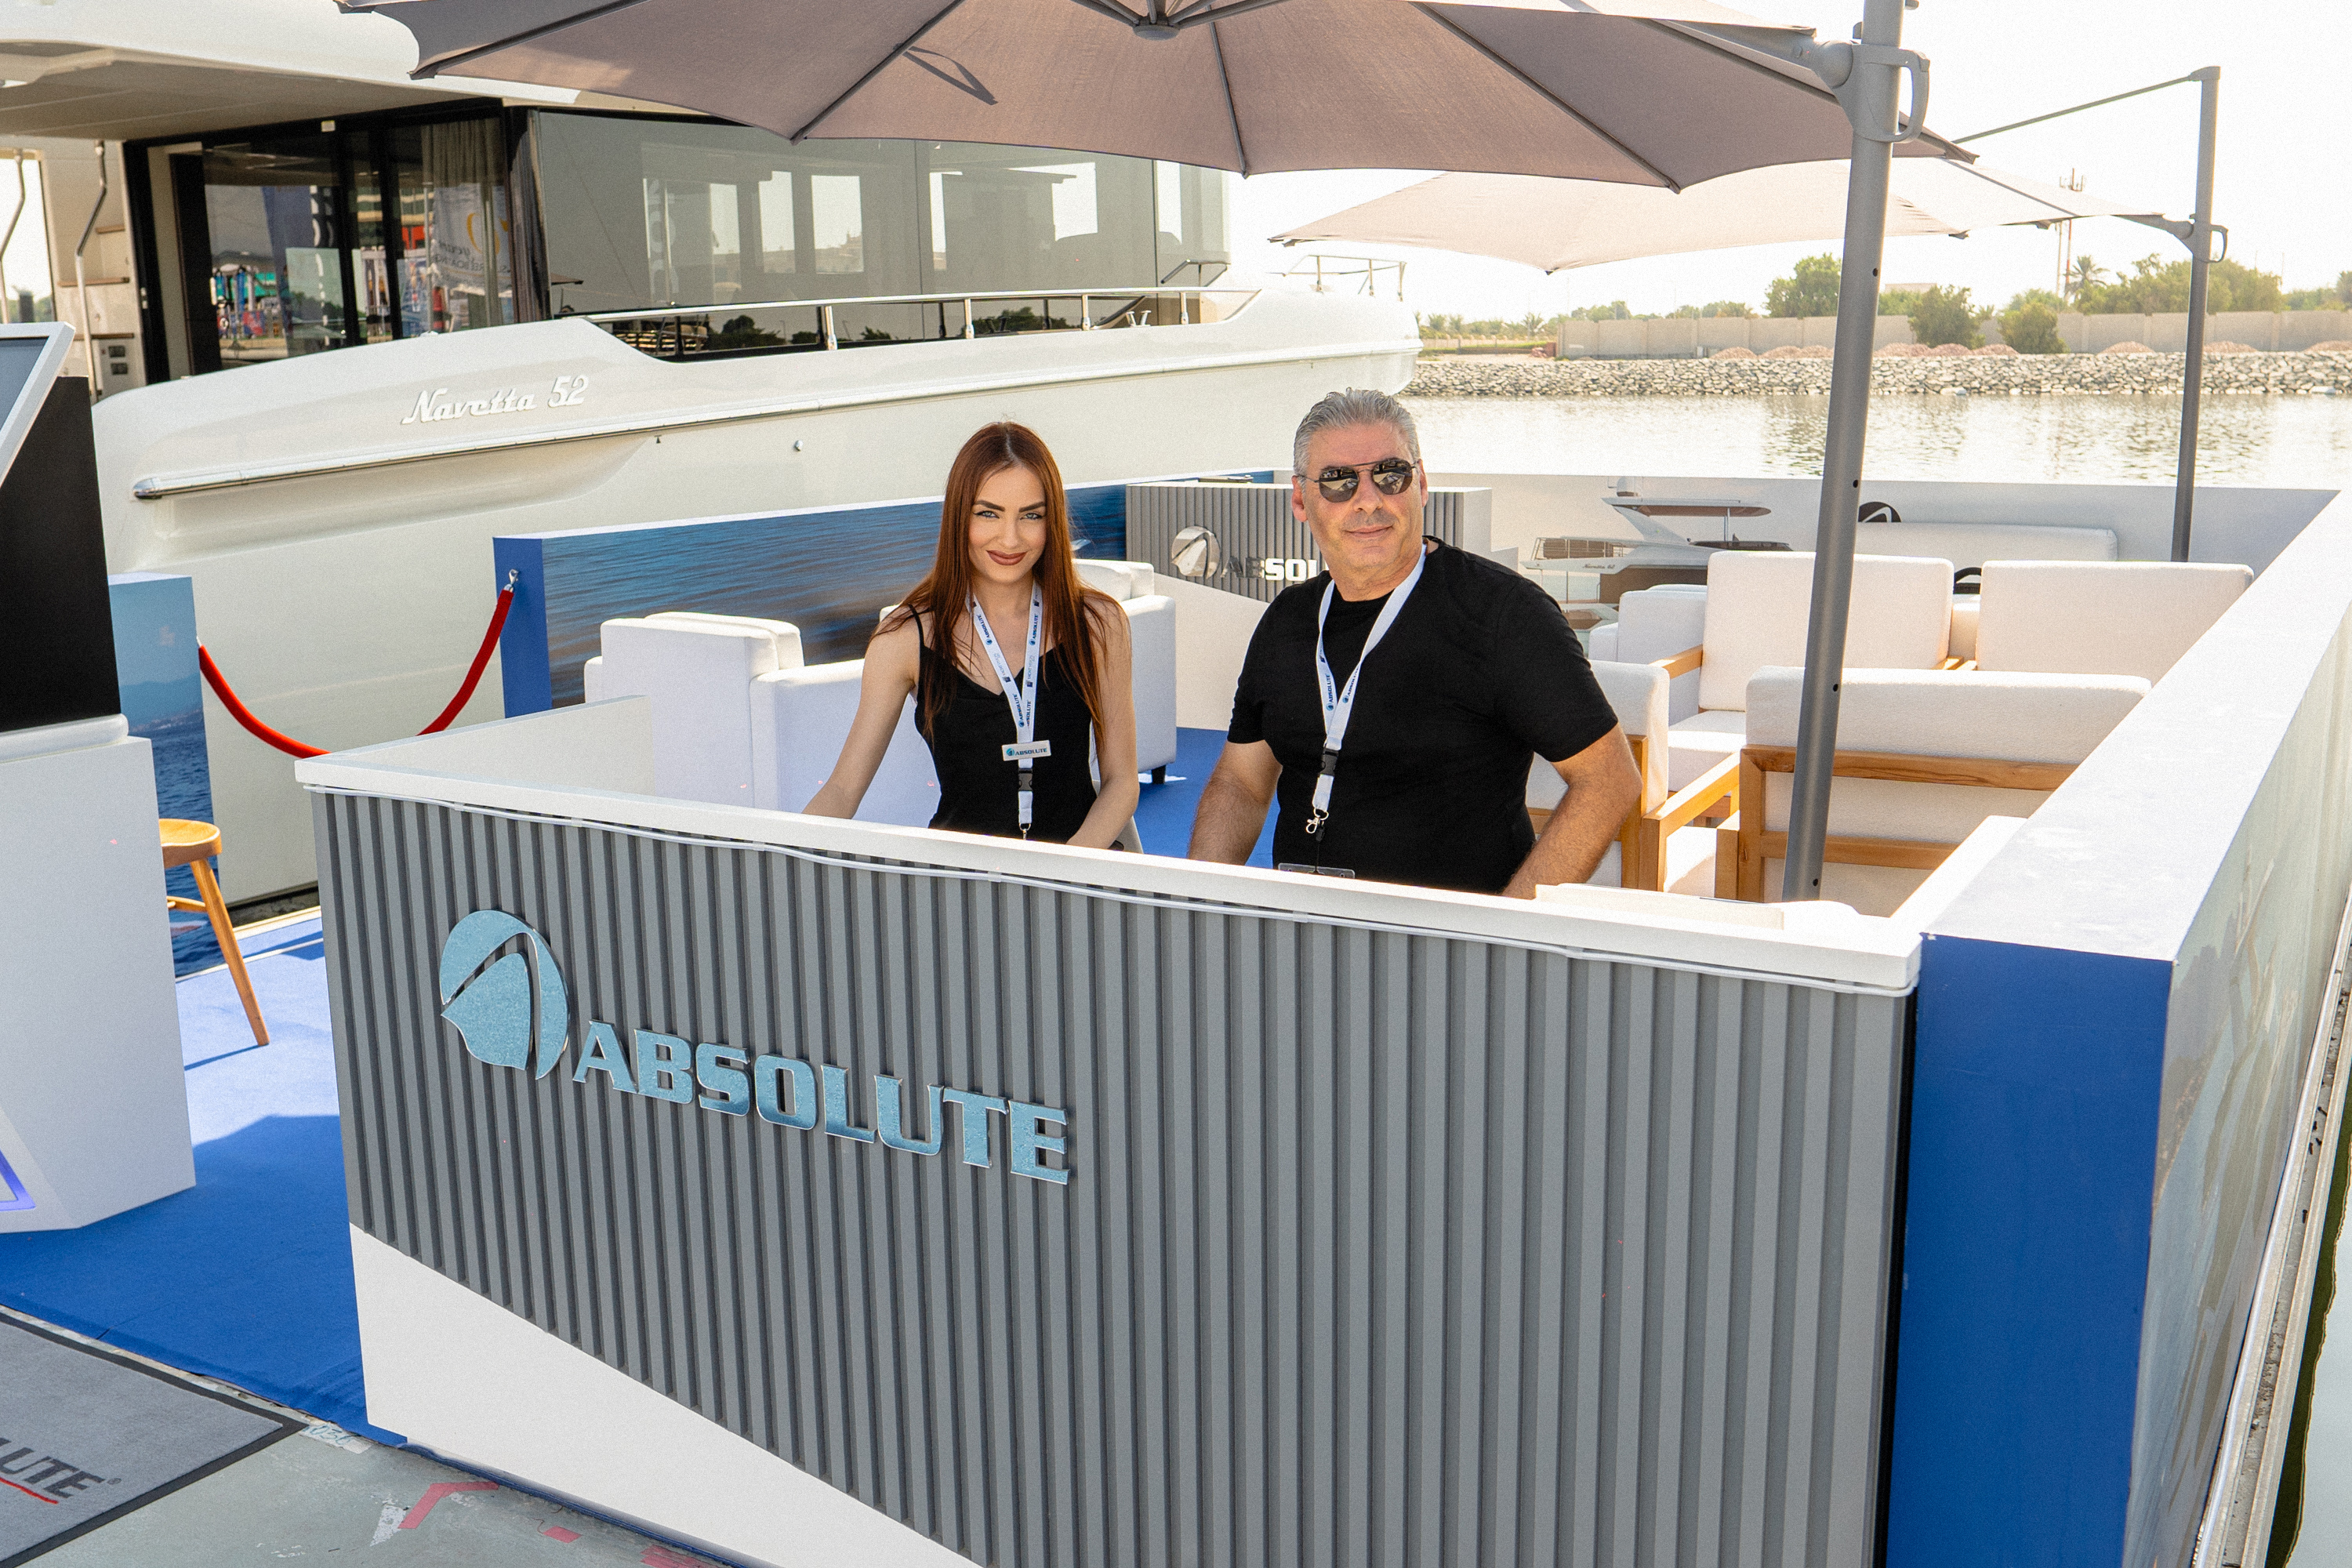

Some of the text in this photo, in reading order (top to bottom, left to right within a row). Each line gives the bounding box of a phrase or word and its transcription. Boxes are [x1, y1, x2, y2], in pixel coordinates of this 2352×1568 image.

[401, 374, 589, 425] Navetta 52
[977, 614, 990, 638] ABSOLUTE
[1325, 673, 1334, 702] ABSOLUTE
[1013, 694, 1023, 720] ABSOLUTE
[1014, 748, 1047, 757] ABSOLUTE
[572, 1019, 1071, 1185] ABSOLUTE
